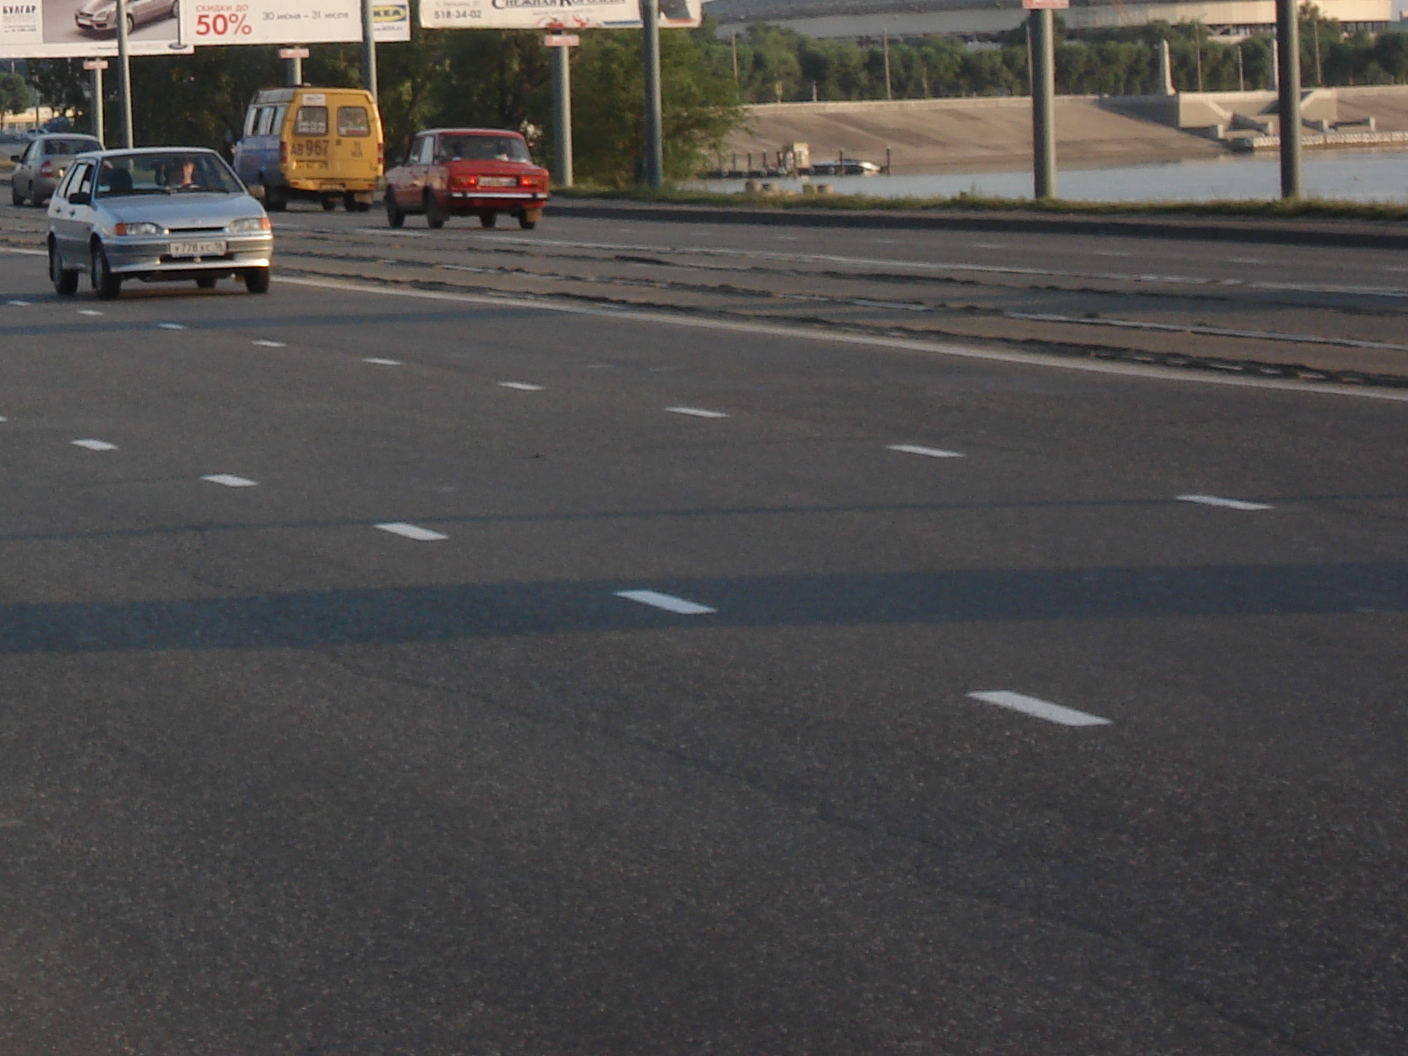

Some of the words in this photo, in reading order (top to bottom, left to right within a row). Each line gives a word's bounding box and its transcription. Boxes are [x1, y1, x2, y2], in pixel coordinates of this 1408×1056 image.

[2, 5, 37, 15] БУЛГАР
[373, 9, 401, 19] KEA
[195, 13, 252, 36] 50%
[305, 139, 330, 156] 967
